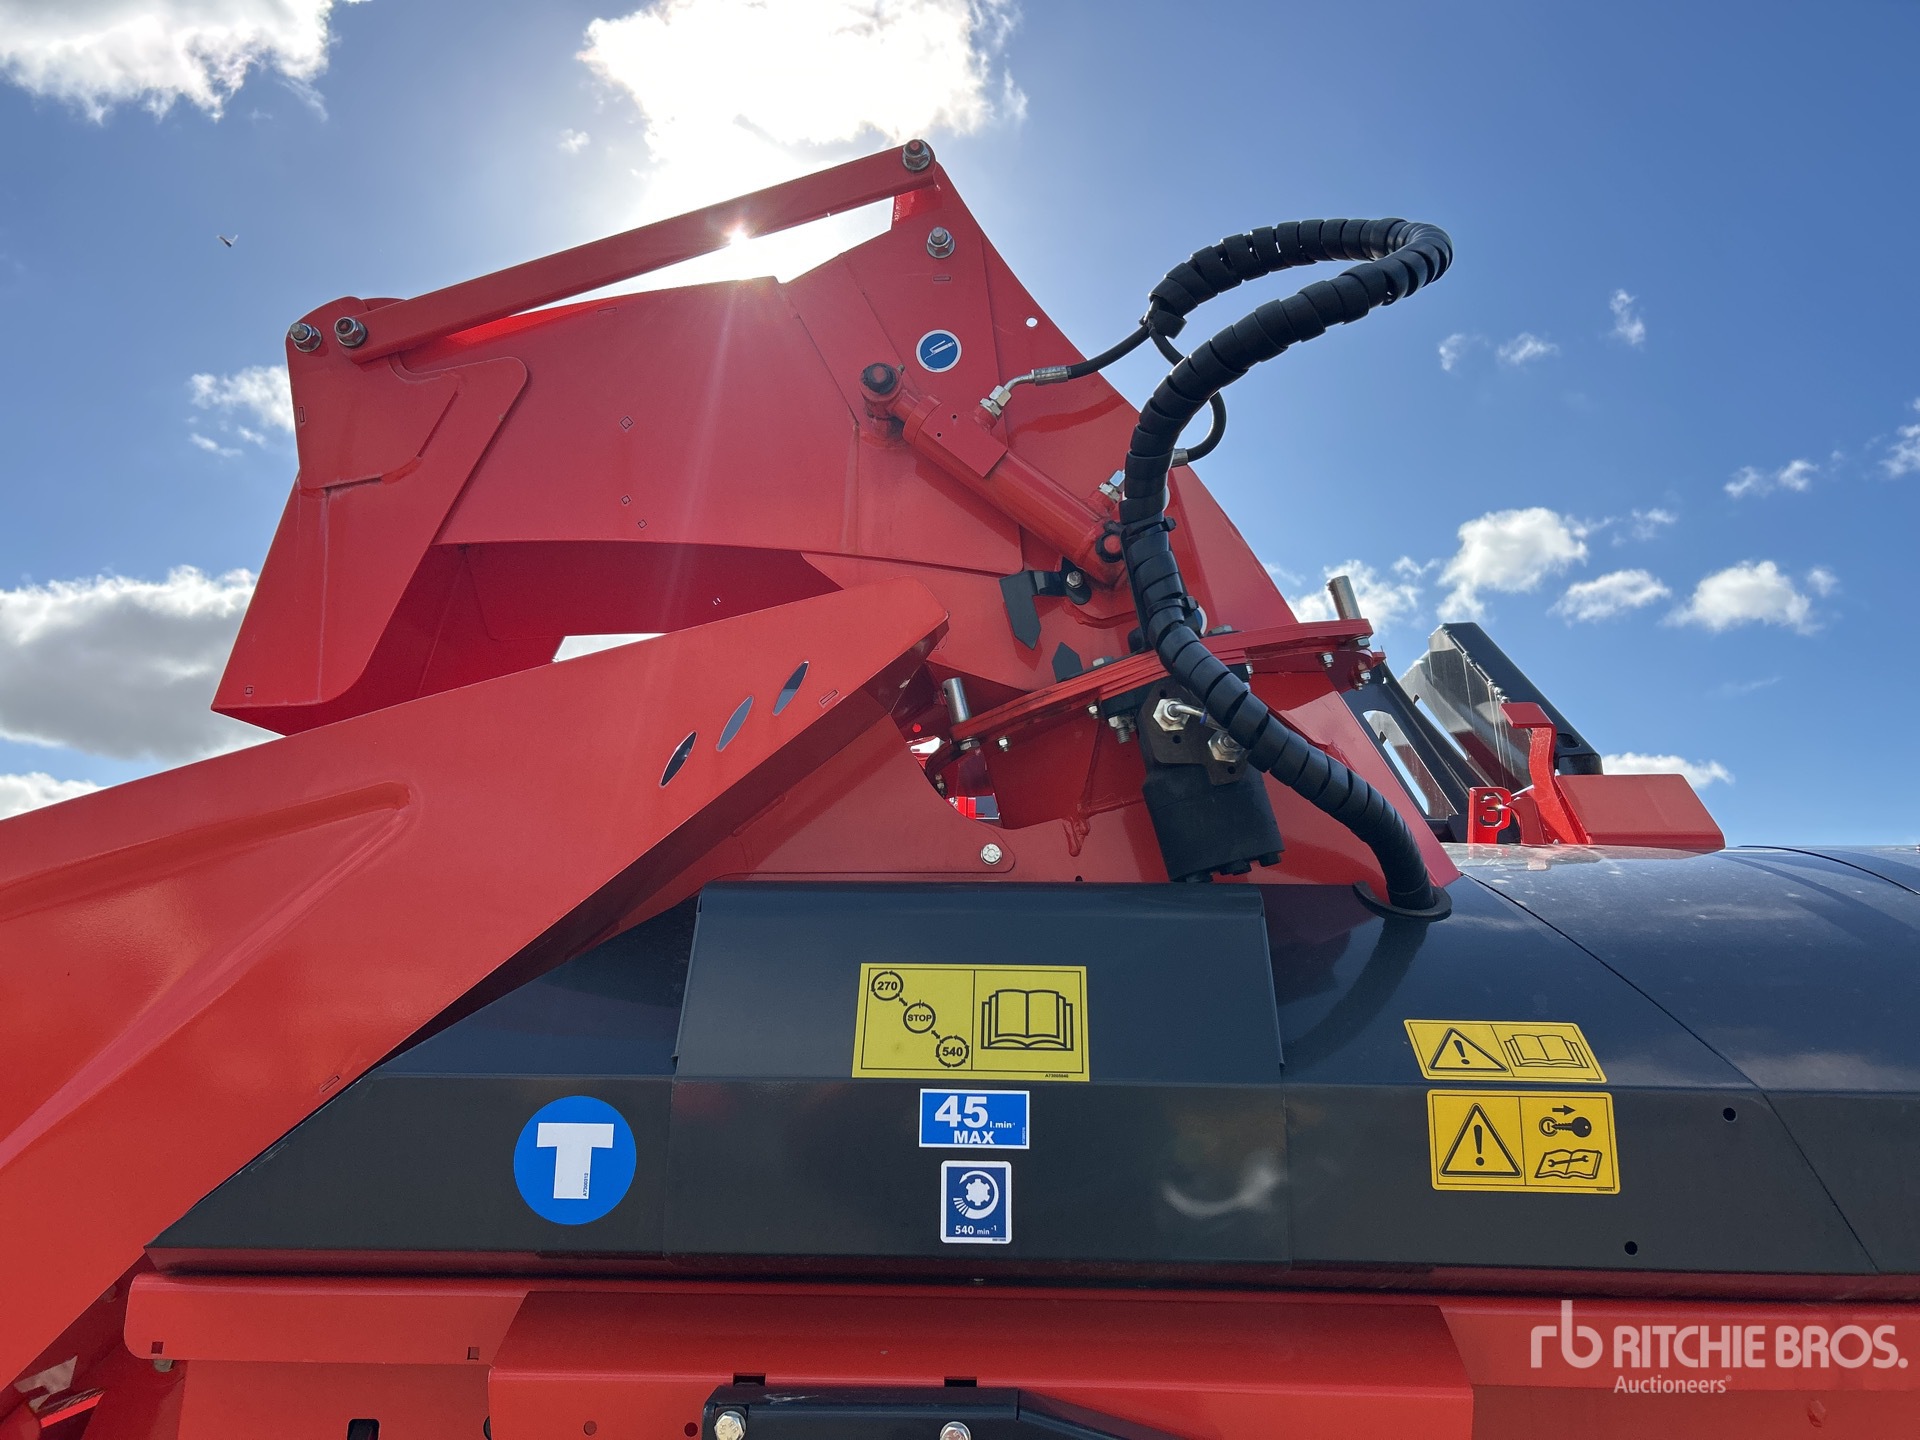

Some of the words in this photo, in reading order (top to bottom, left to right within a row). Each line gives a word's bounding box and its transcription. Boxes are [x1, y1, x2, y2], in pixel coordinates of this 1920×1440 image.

[1479, 791, 1503, 828] 3
[877, 981, 898, 991] 270
[907, 1013, 932, 1023] STOP
[942, 1047, 963, 1057] 540
[934, 1095, 989, 1128] 45
[953, 1130, 995, 1145] MAX
[536, 1122, 615, 1200] T
[955, 1225, 975, 1235] 540
